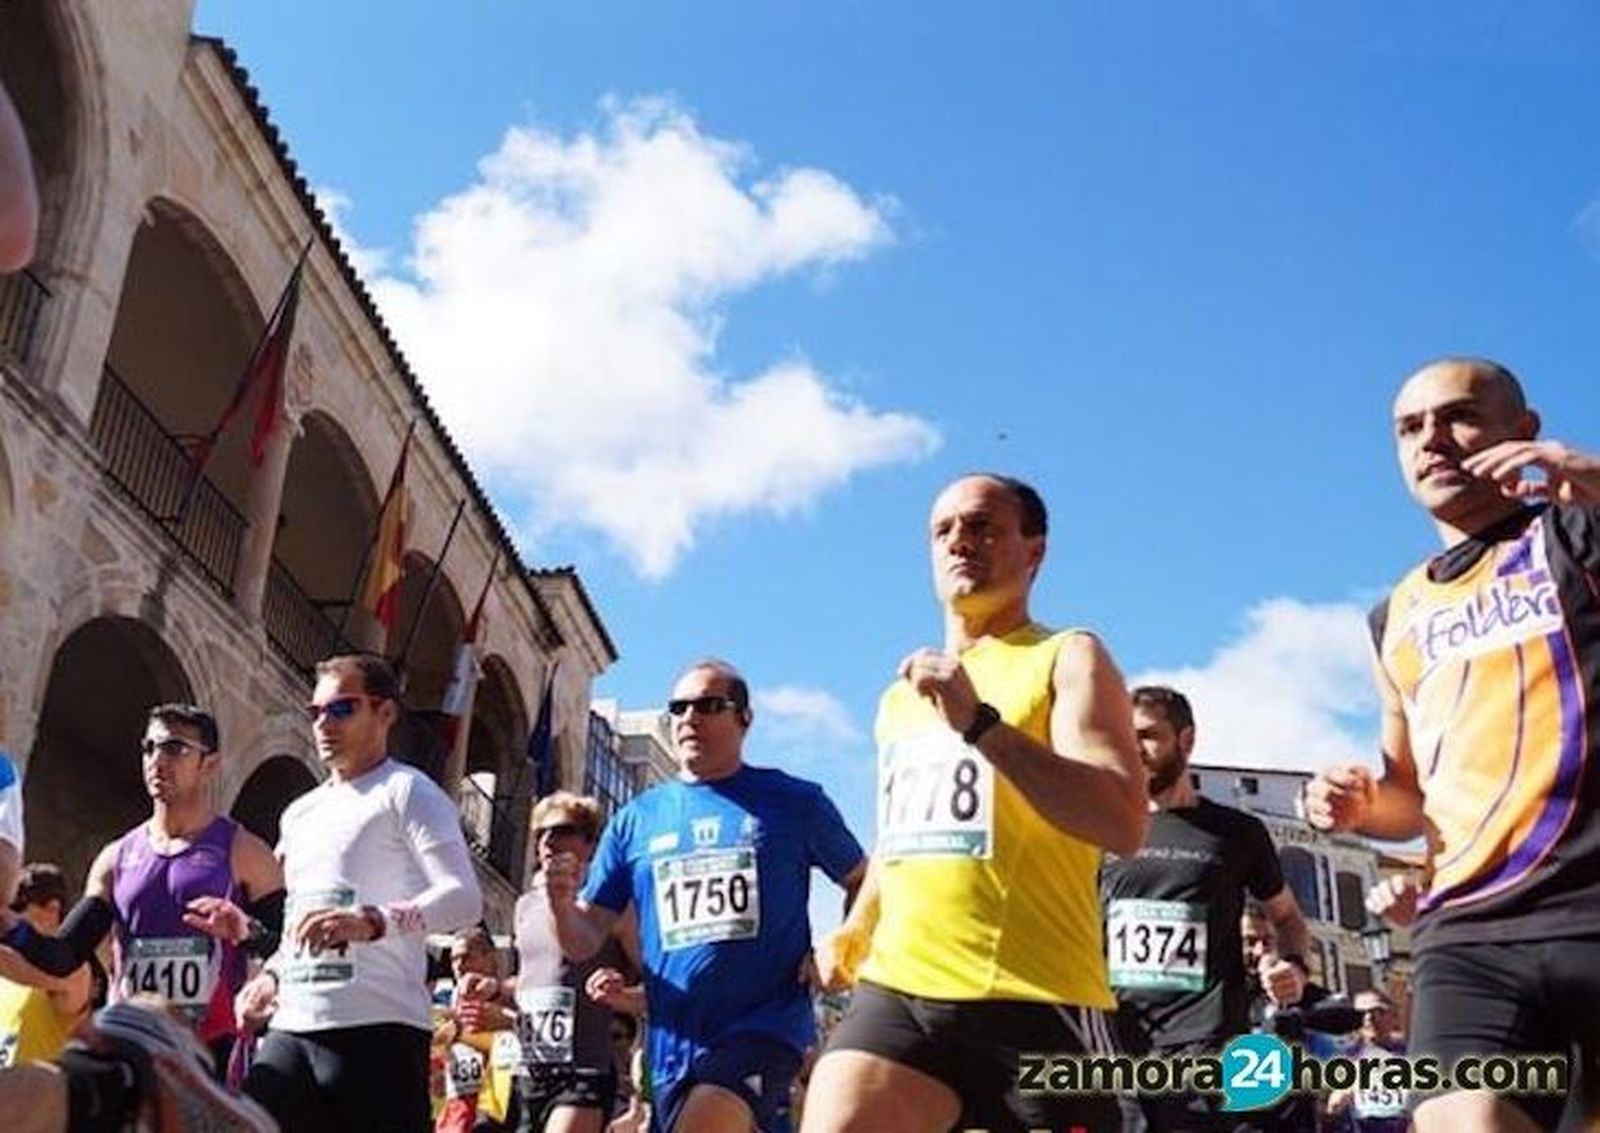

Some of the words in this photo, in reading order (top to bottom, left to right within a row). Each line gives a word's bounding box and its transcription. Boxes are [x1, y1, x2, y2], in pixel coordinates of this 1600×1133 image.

[665, 874, 748, 923] 1750
[1116, 923, 1197, 967] 1374
[128, 960, 200, 999] 1410
